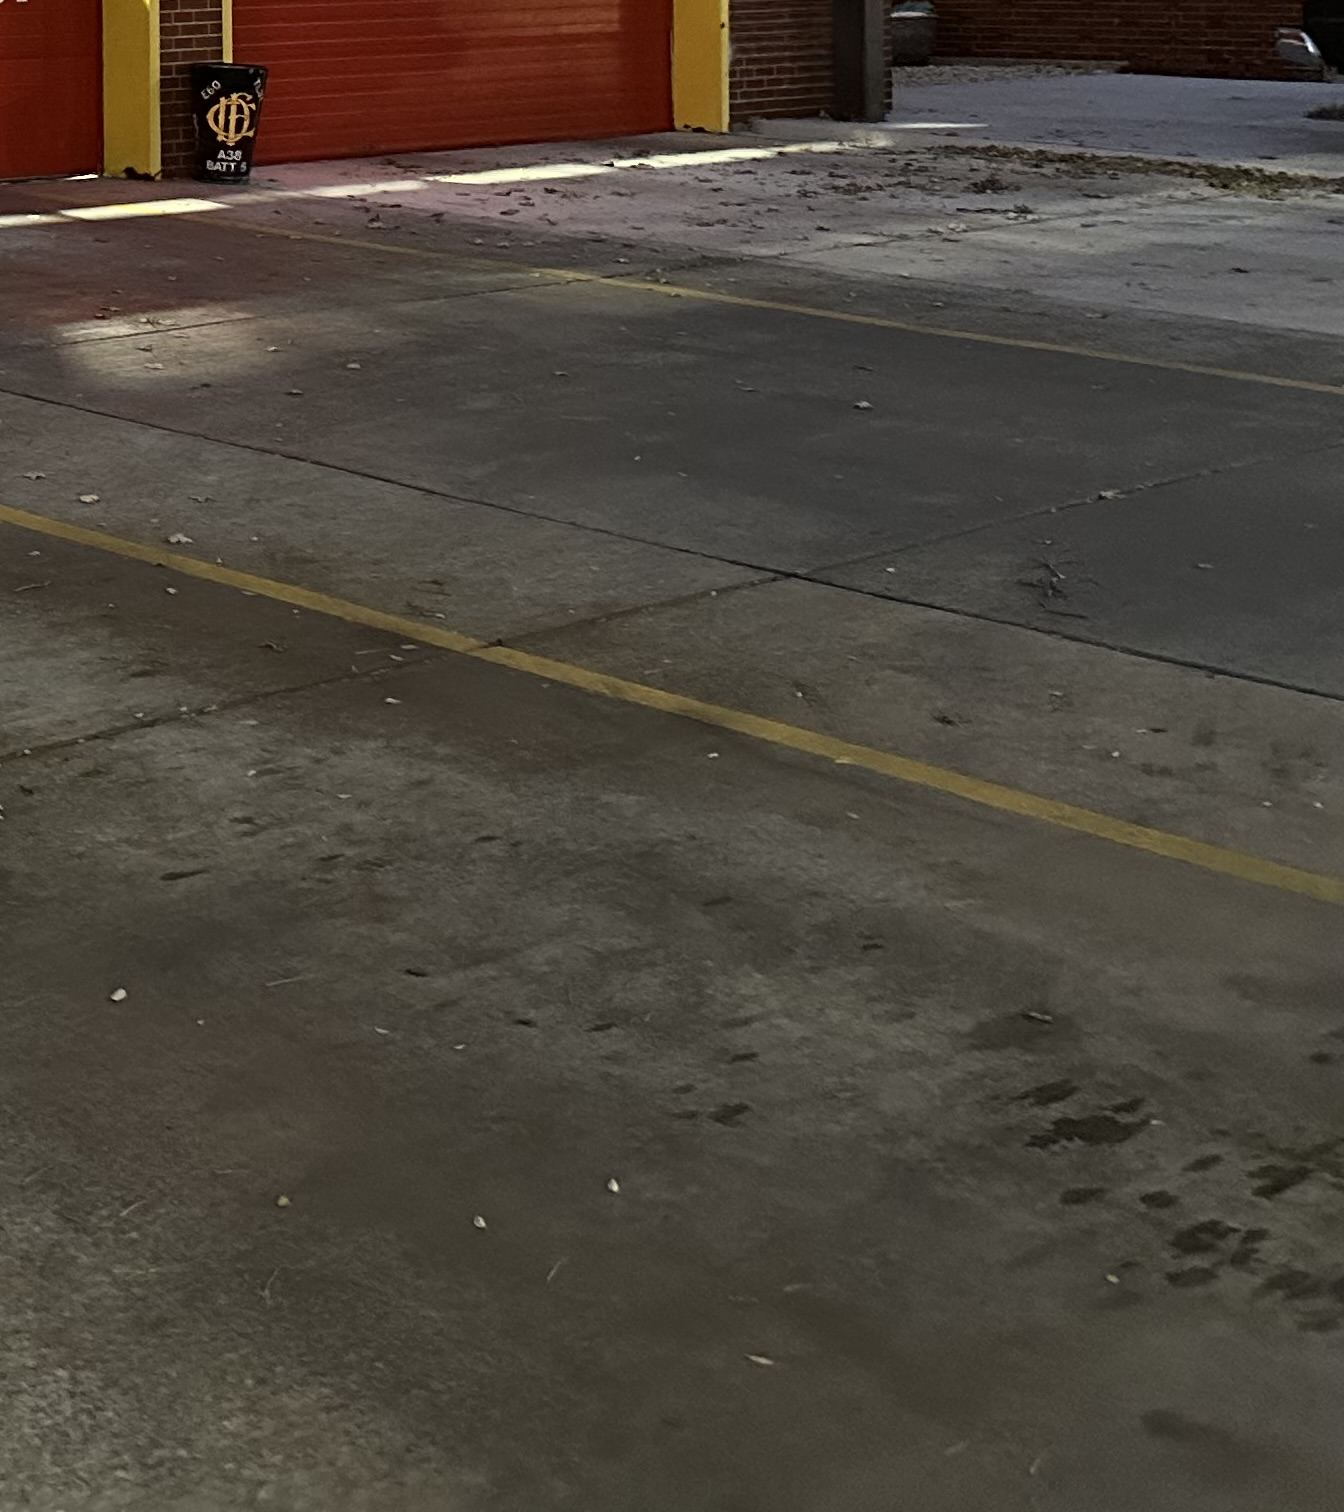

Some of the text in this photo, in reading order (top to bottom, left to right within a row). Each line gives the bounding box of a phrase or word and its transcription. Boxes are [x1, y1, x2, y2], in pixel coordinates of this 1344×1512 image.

[200, 79, 222, 100] E60
[217, 149, 243, 161] A38
[206, 159, 247, 172] BATT 5
